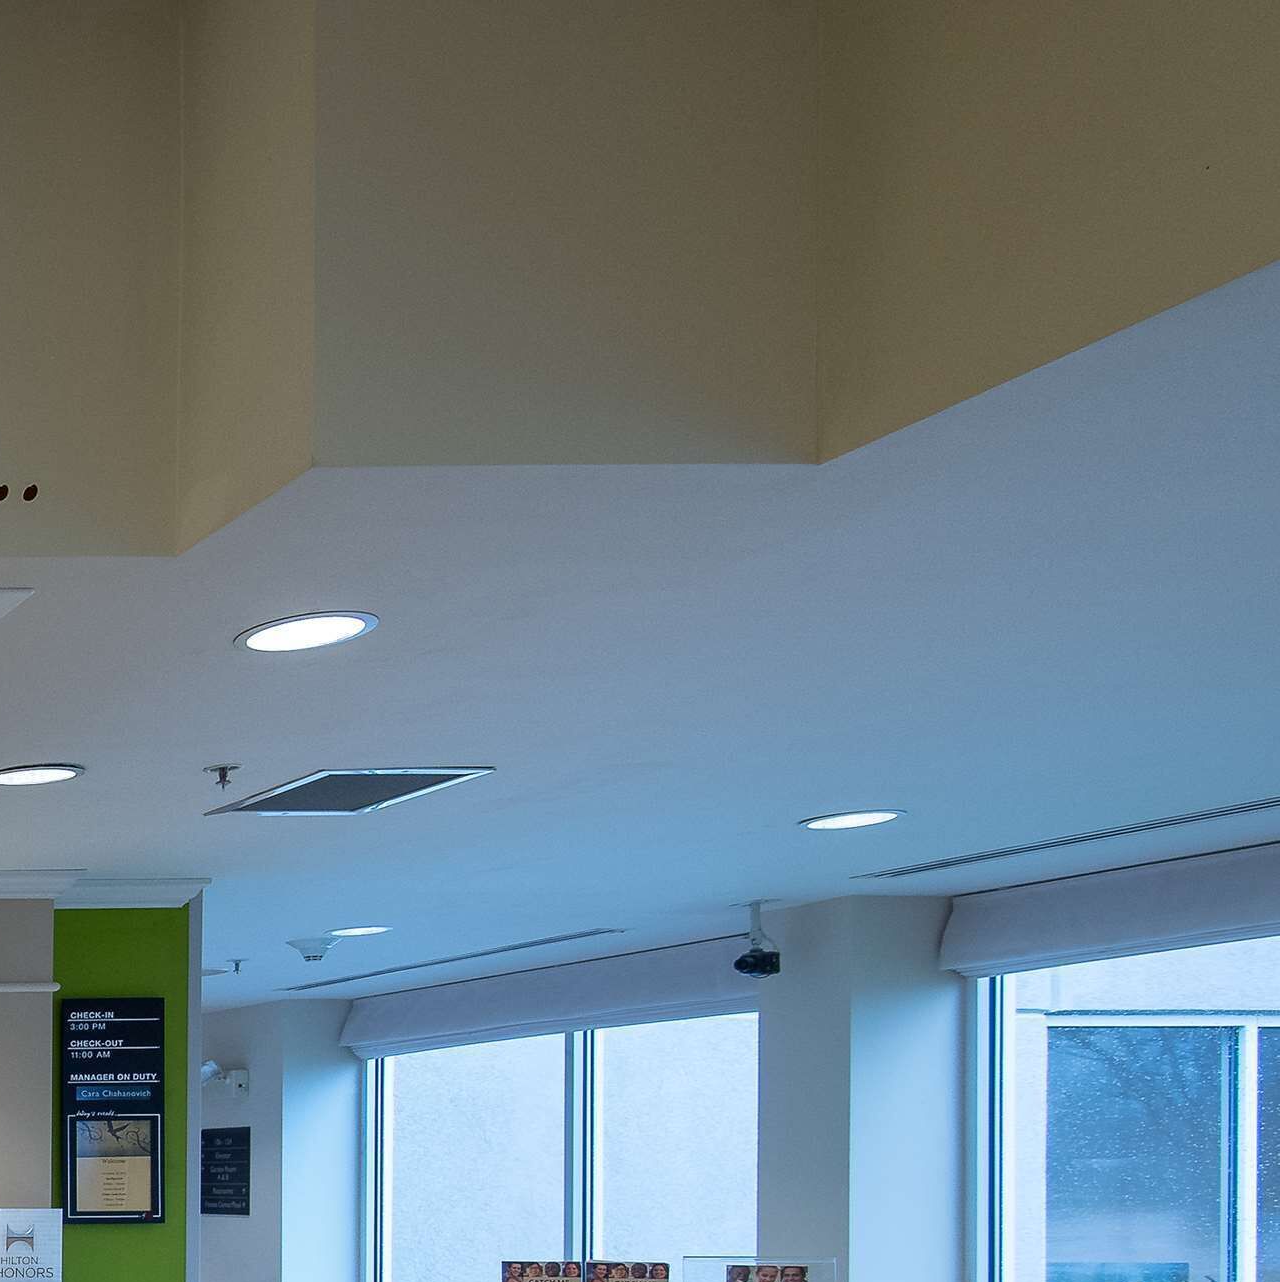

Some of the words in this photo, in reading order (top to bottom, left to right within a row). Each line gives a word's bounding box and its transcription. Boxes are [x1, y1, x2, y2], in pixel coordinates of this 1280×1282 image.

[70, 1011, 114, 1019] CHECK-IN
[92, 1022, 106, 1030] PM
[0, 1256, 39, 1264] HILTON
